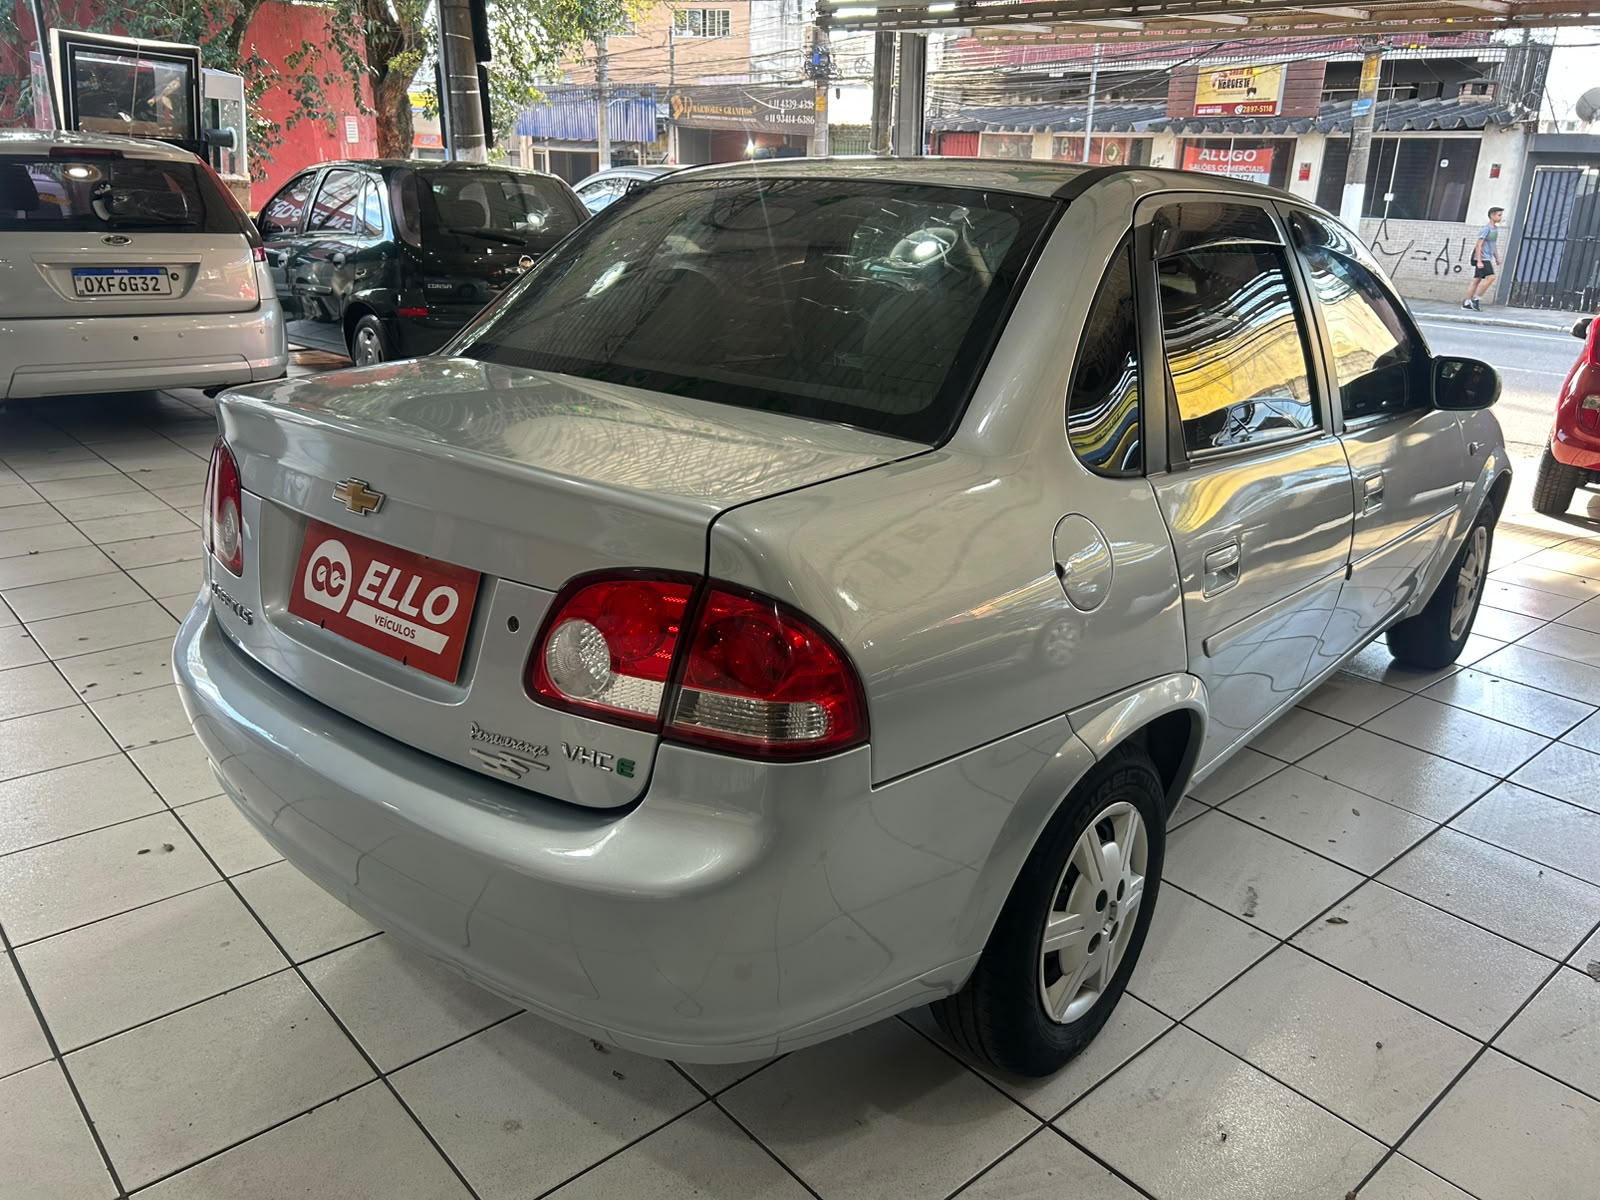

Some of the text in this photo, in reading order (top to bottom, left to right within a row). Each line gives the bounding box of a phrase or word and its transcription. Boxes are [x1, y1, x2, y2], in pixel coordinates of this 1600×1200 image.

[1198, 149, 1257, 162] ALUGO
[1217, 164, 1264, 173] COMERCIAIS
[84, 276, 161, 293] OXF6G32
[357, 559, 459, 625] ELLO
[374, 613, 416, 639] VEÍCULOS
